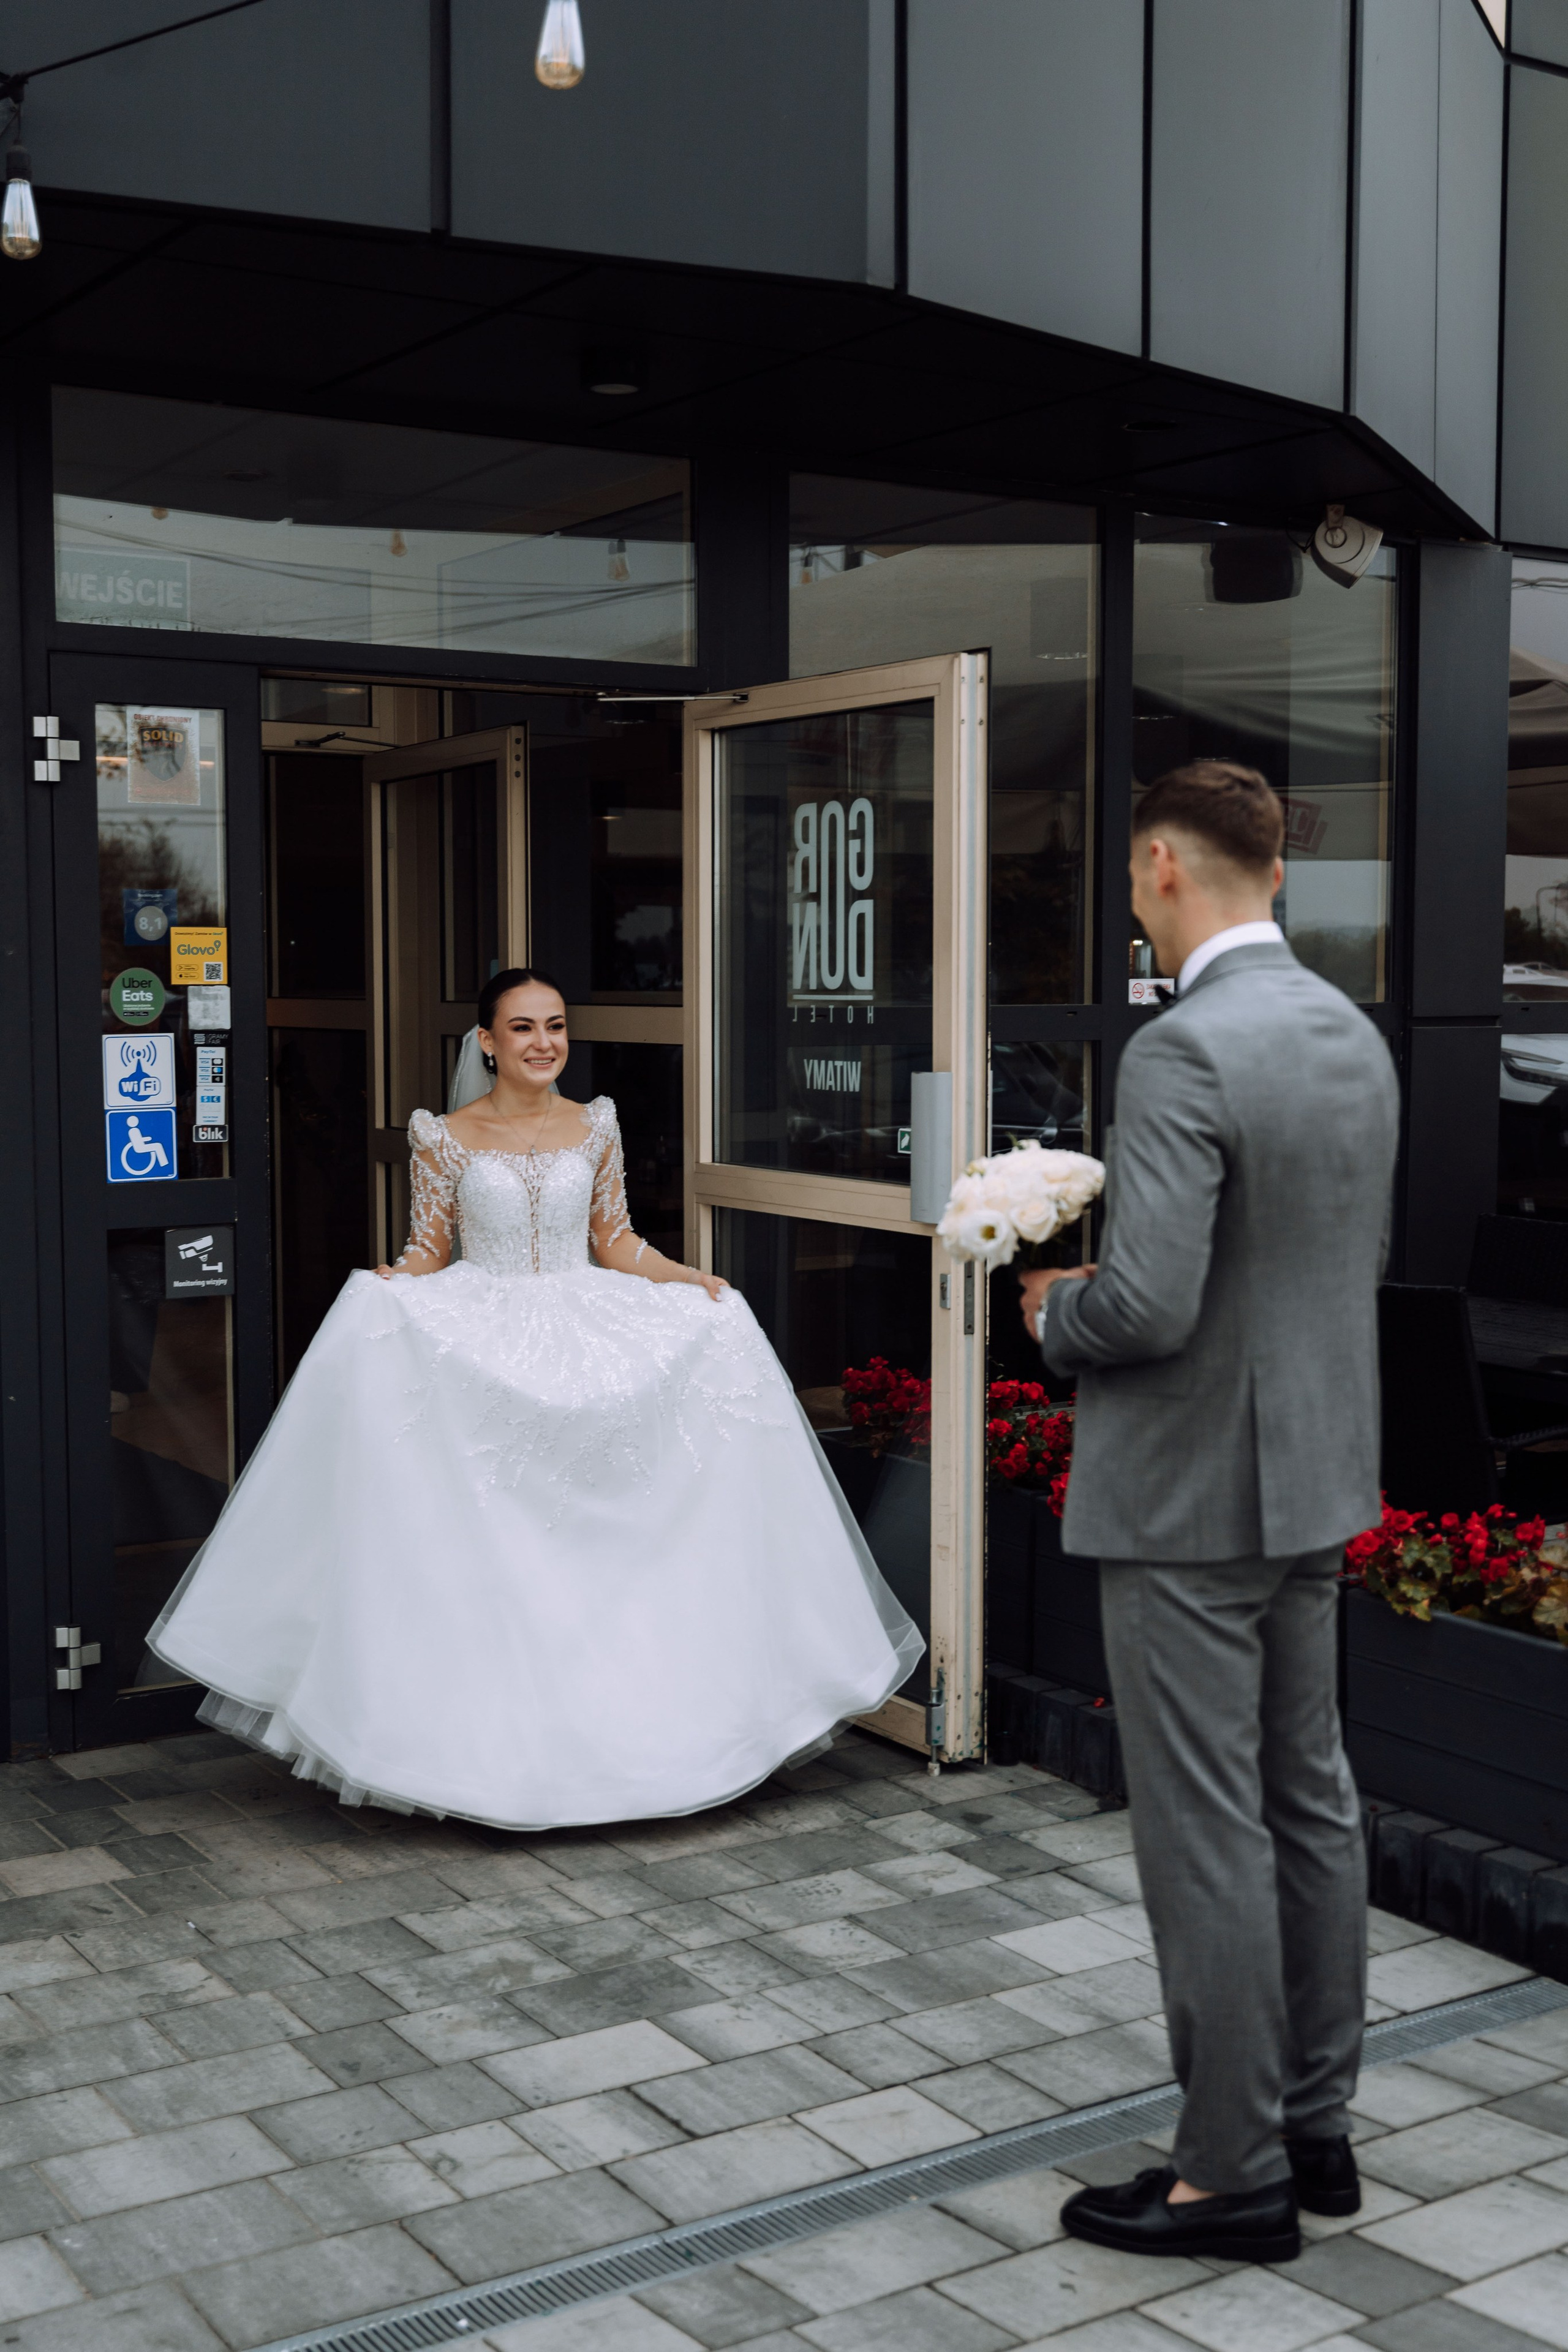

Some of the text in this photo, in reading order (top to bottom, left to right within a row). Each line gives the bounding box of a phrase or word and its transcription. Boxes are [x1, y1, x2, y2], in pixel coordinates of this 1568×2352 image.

[56, 571, 183, 608] WEJŚCIE
[143, 729, 184, 743] SOLID
[139, 917, 162, 932] 8,1
[177, 944, 215, 956] Glovo
[123, 978, 153, 989] Uber
[123, 990, 154, 1001] Eats
[198, 1128, 224, 1140] blik
[206, 1278, 228, 1286] wizyjny
